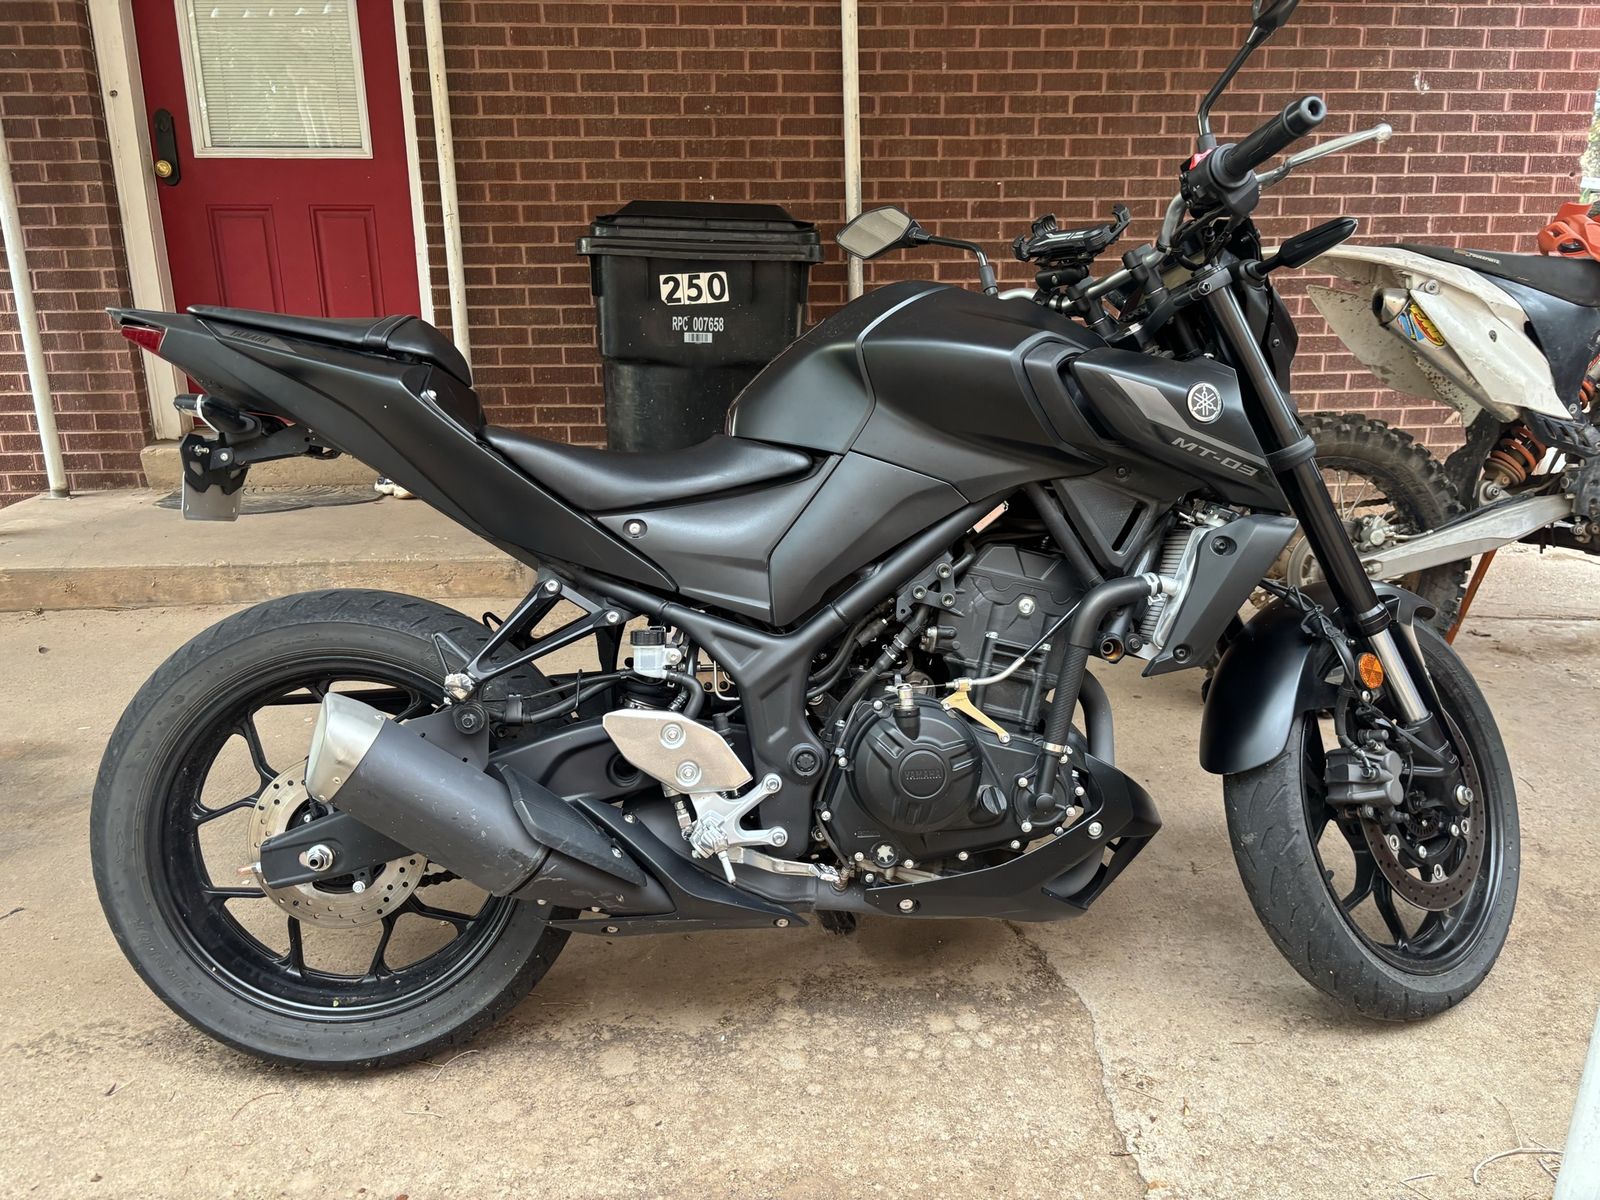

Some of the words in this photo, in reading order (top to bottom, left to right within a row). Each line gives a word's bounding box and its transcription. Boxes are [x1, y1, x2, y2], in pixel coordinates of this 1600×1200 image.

[662, 273, 726, 303] 250
[672, 316, 689, 331] RPC
[692, 316, 724, 332] 007658
[231, 330, 271, 344] YAMAHA
[1171, 437, 1258, 476] MT-03
[904, 768, 943, 780] YAMAHA
